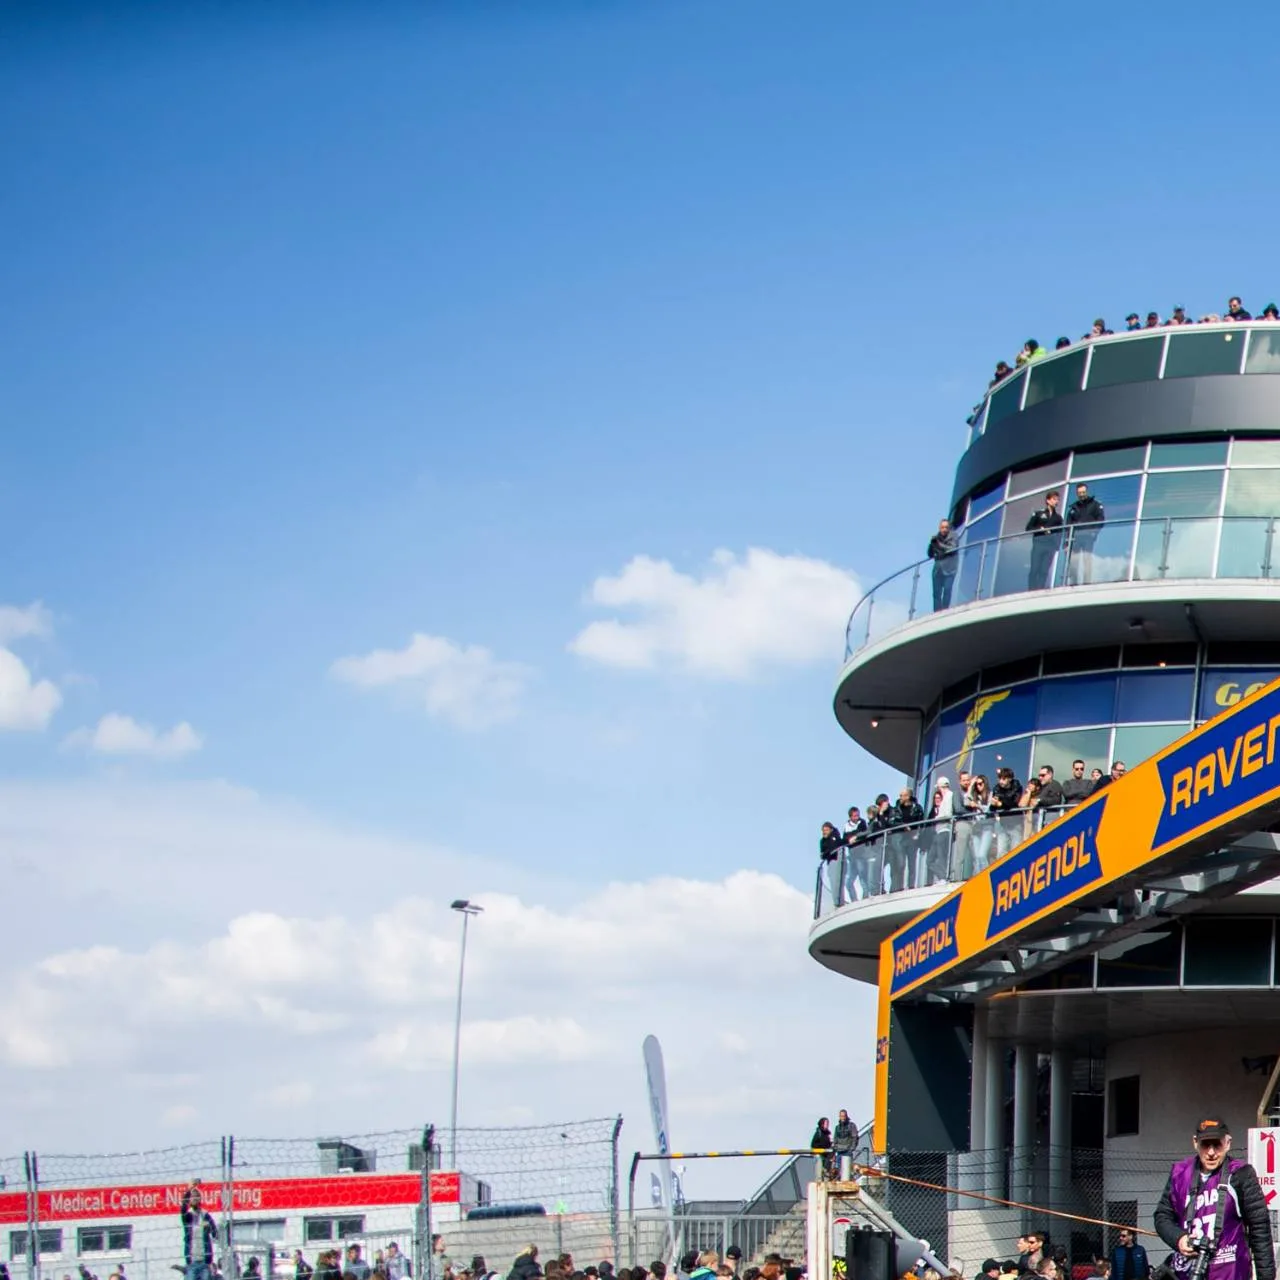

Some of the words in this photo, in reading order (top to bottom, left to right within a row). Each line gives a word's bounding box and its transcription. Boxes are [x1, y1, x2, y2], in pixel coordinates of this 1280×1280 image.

[995, 832, 1092, 916] RAVENOL
[896, 921, 953, 977] RAVENOL
[50, 1191, 105, 1213] Medical
[110, 1188, 160, 1210] Center
